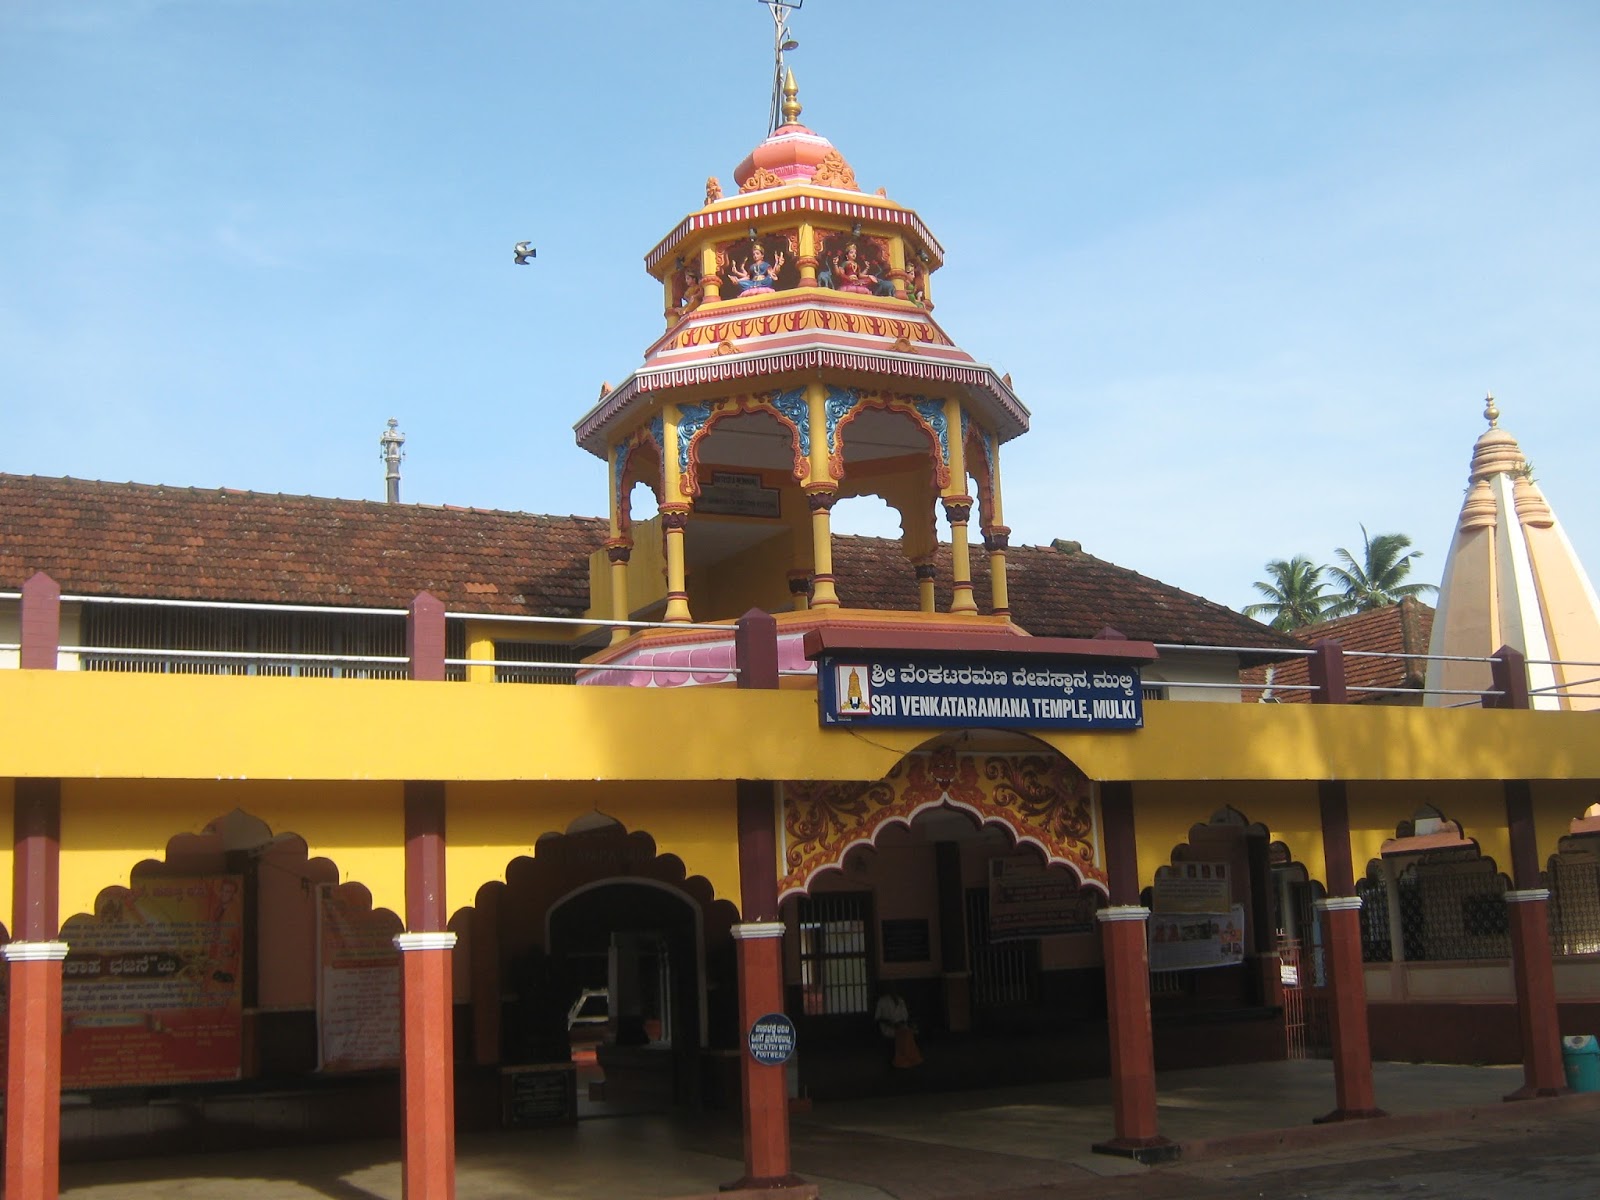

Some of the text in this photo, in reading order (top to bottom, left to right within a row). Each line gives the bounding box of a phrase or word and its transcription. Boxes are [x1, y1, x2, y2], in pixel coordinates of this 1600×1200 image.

[871, 663, 1134, 696] ಶ್ರೀ ವೆಂಕಟರಮಣ ದೇವಸ್ಥಾನ, ಮುಲ್ಕಿ
[871, 694, 1136, 722] SRI VENKATARAMANA TEMPLE, MULKI
[755, 1051, 786, 1059] FOOTWEAR
